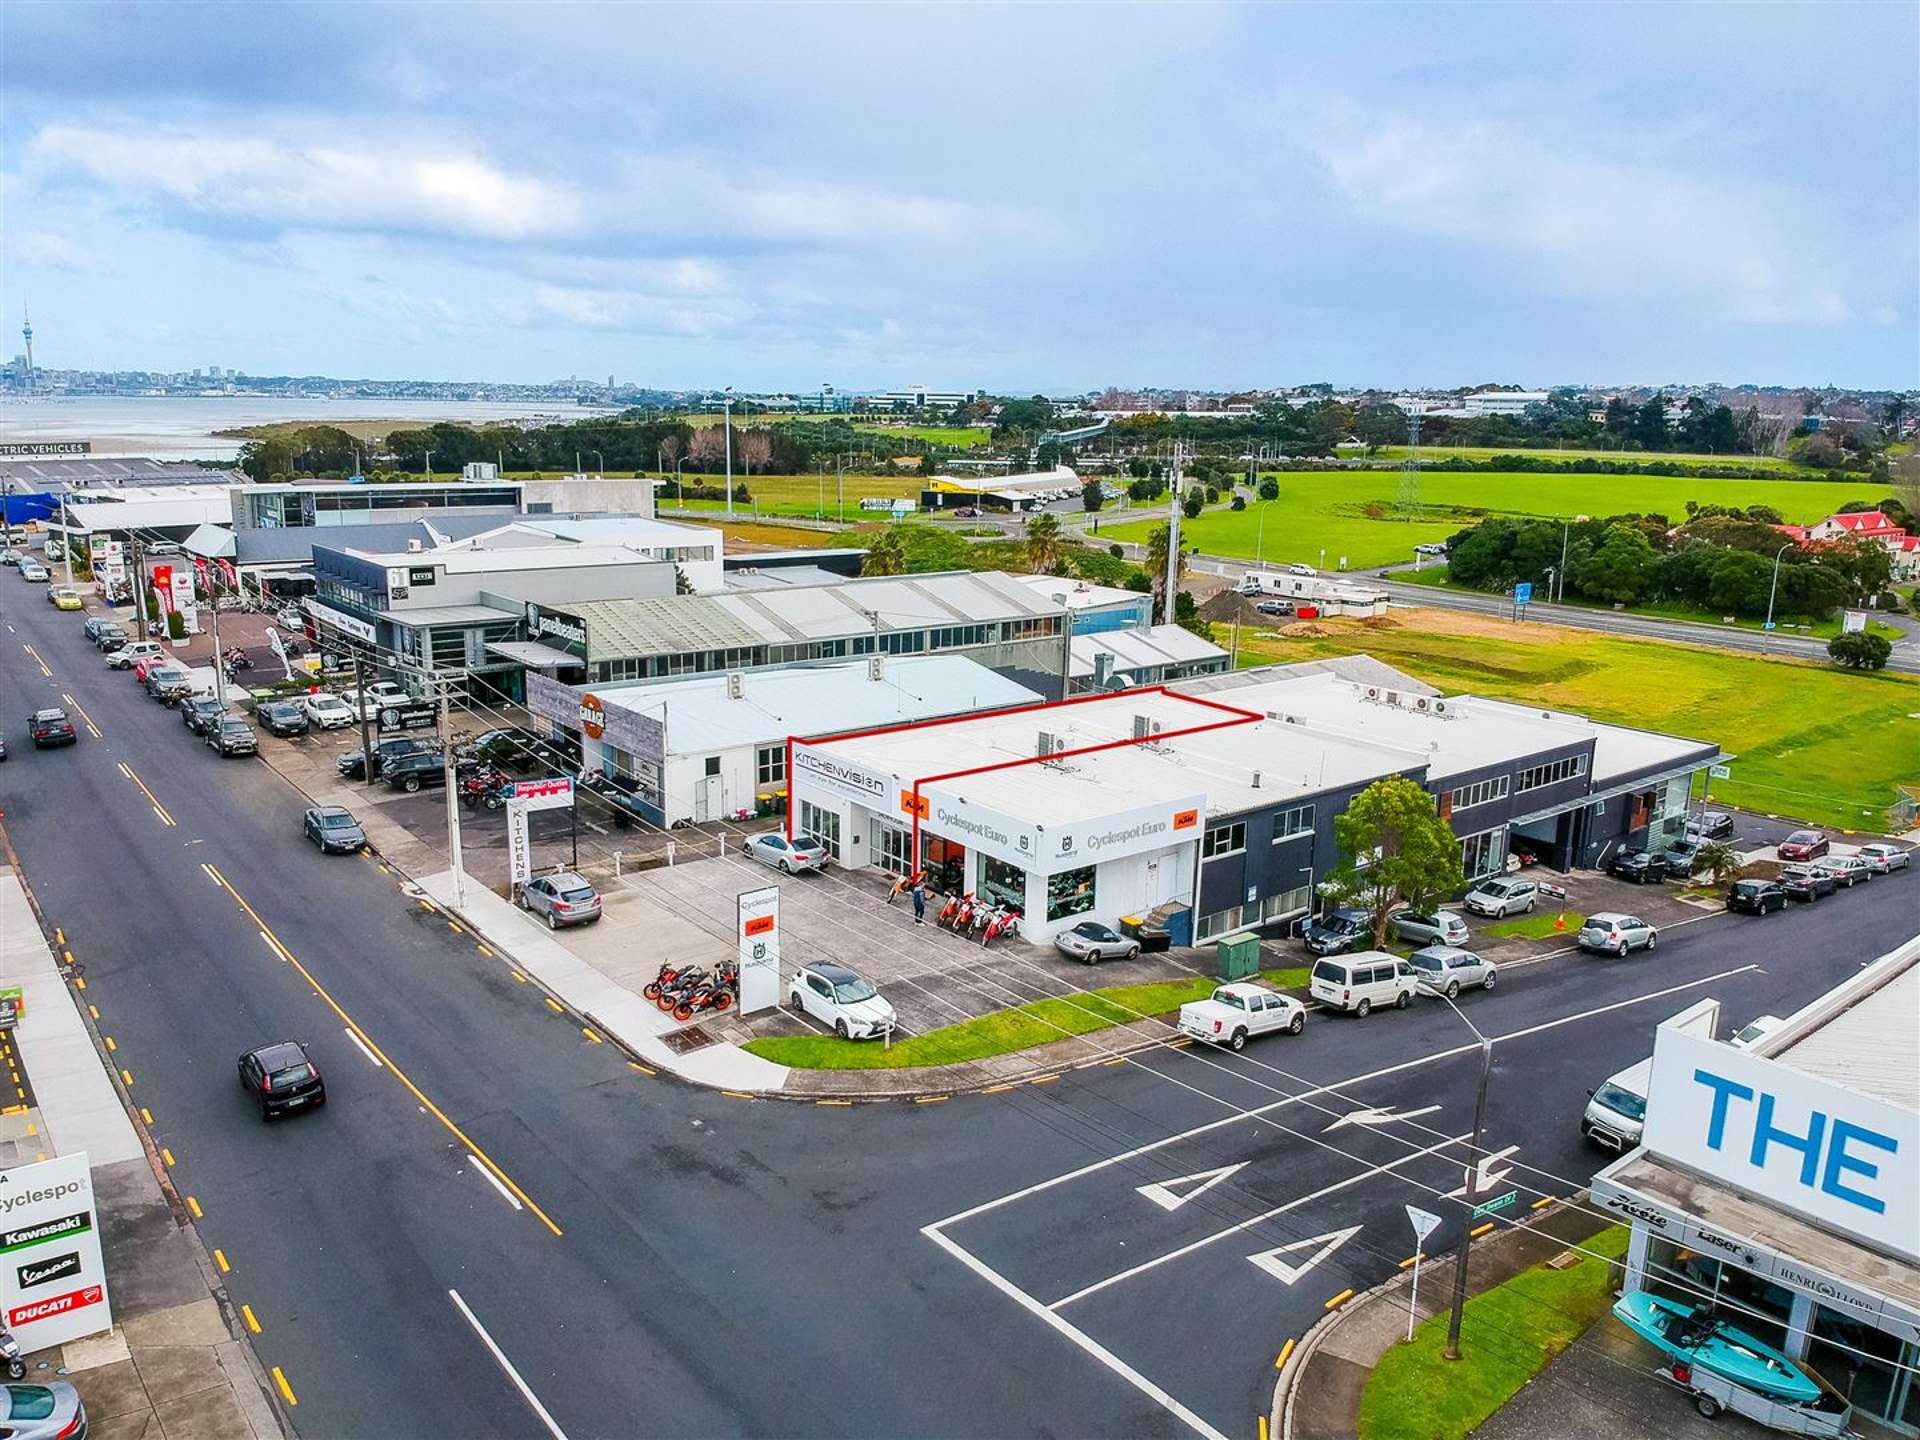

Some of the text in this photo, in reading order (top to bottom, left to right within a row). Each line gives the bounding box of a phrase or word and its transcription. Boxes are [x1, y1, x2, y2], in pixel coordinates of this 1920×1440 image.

[0, 444, 83, 455] TRIC VEHICLES
[938, 808, 1008, 846] Cyclespot Euro
[1088, 821, 1166, 850] Cyclespot Euro
[513, 809, 525, 879] KITCHENS
[1694, 1069, 1899, 1215] THE
[0, 1177, 89, 1214] yclespot
[1607, 1193, 1668, 1229] Hobie
[5, 1216, 81, 1246] Kawasaki
[1697, 1227, 1742, 1254] Laser
[22, 1257, 76, 1285] Vespa
[1780, 1268, 1816, 1291] HENRI
[15, 1297, 73, 1323] DUCATI
